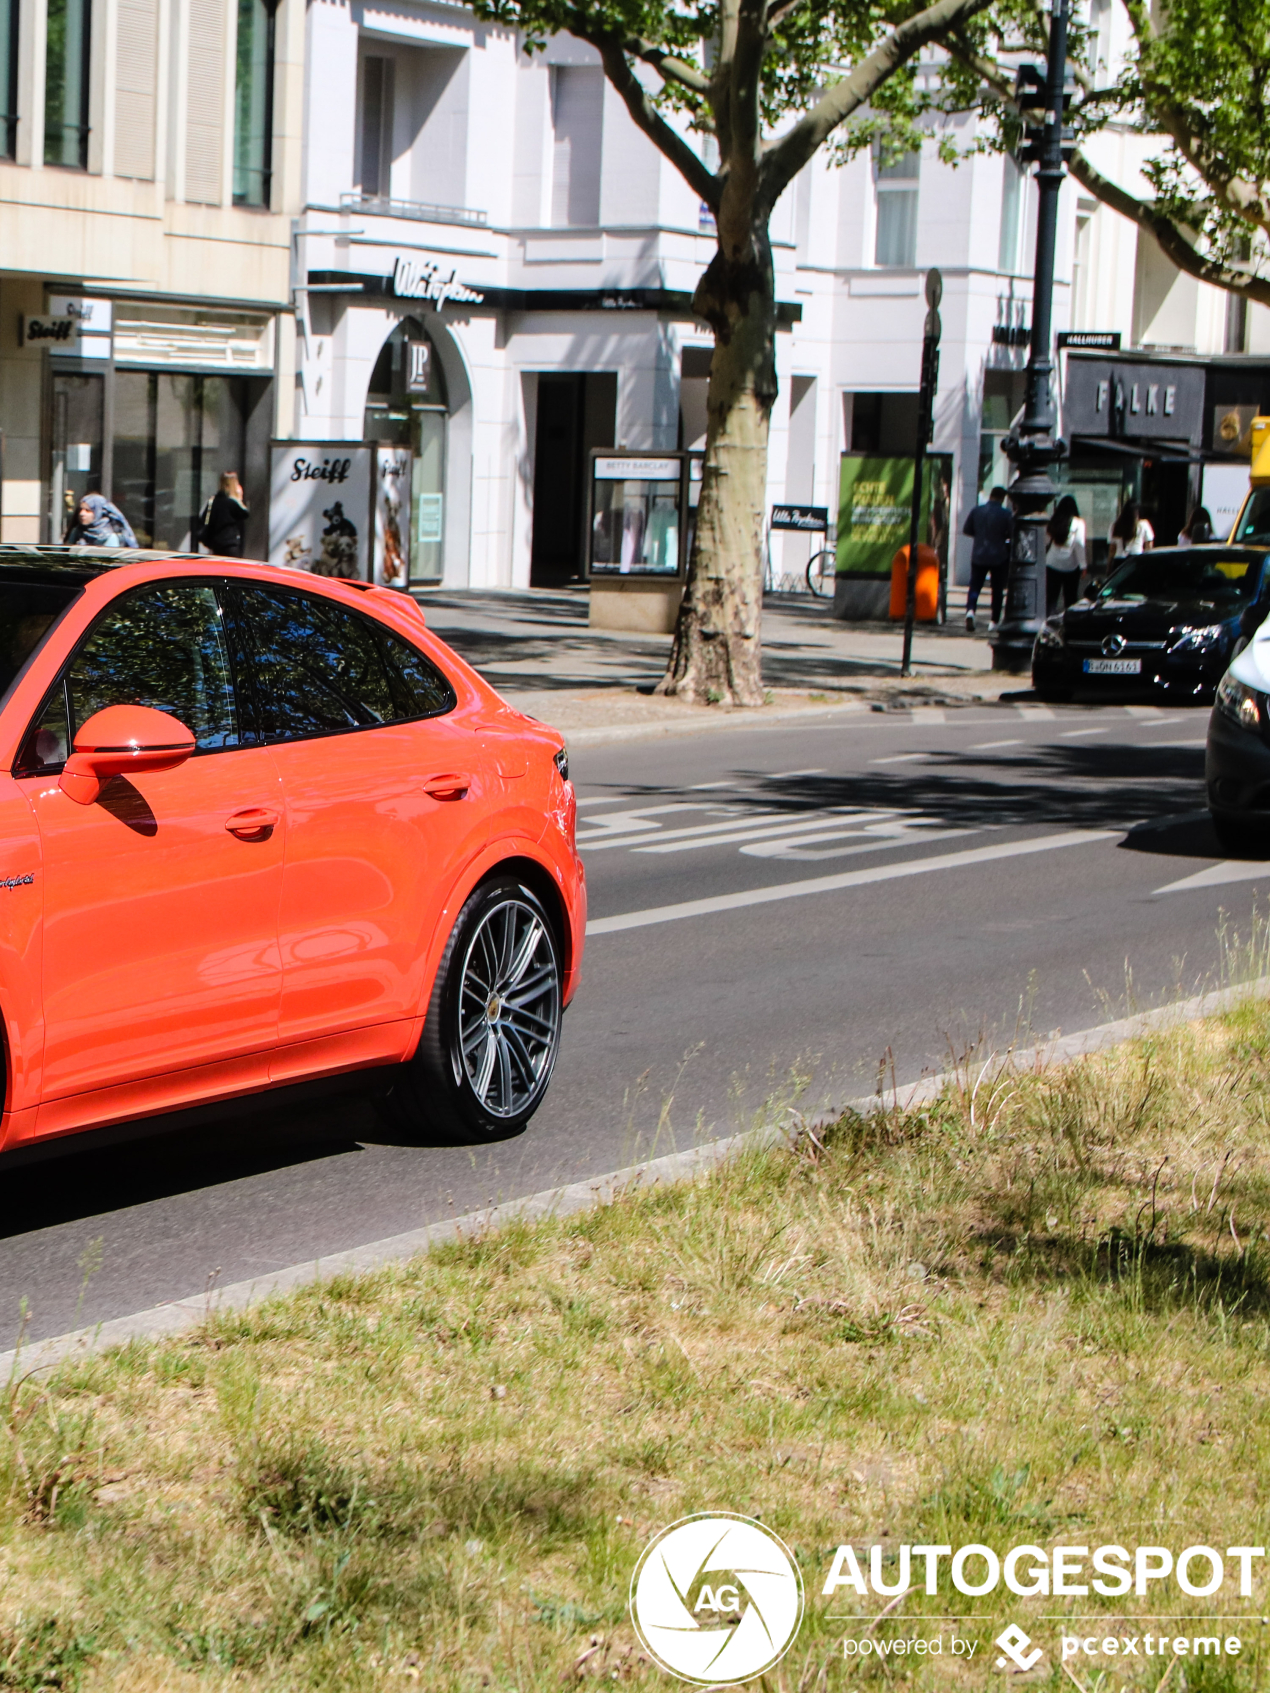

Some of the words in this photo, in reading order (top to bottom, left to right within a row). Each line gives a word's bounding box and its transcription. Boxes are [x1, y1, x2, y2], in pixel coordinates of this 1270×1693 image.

[27, 320, 73, 341] Steiff
[410, 344, 429, 383] JP
[1097, 379, 1177, 416] FALKE
[290, 458, 351, 484] Steiff
